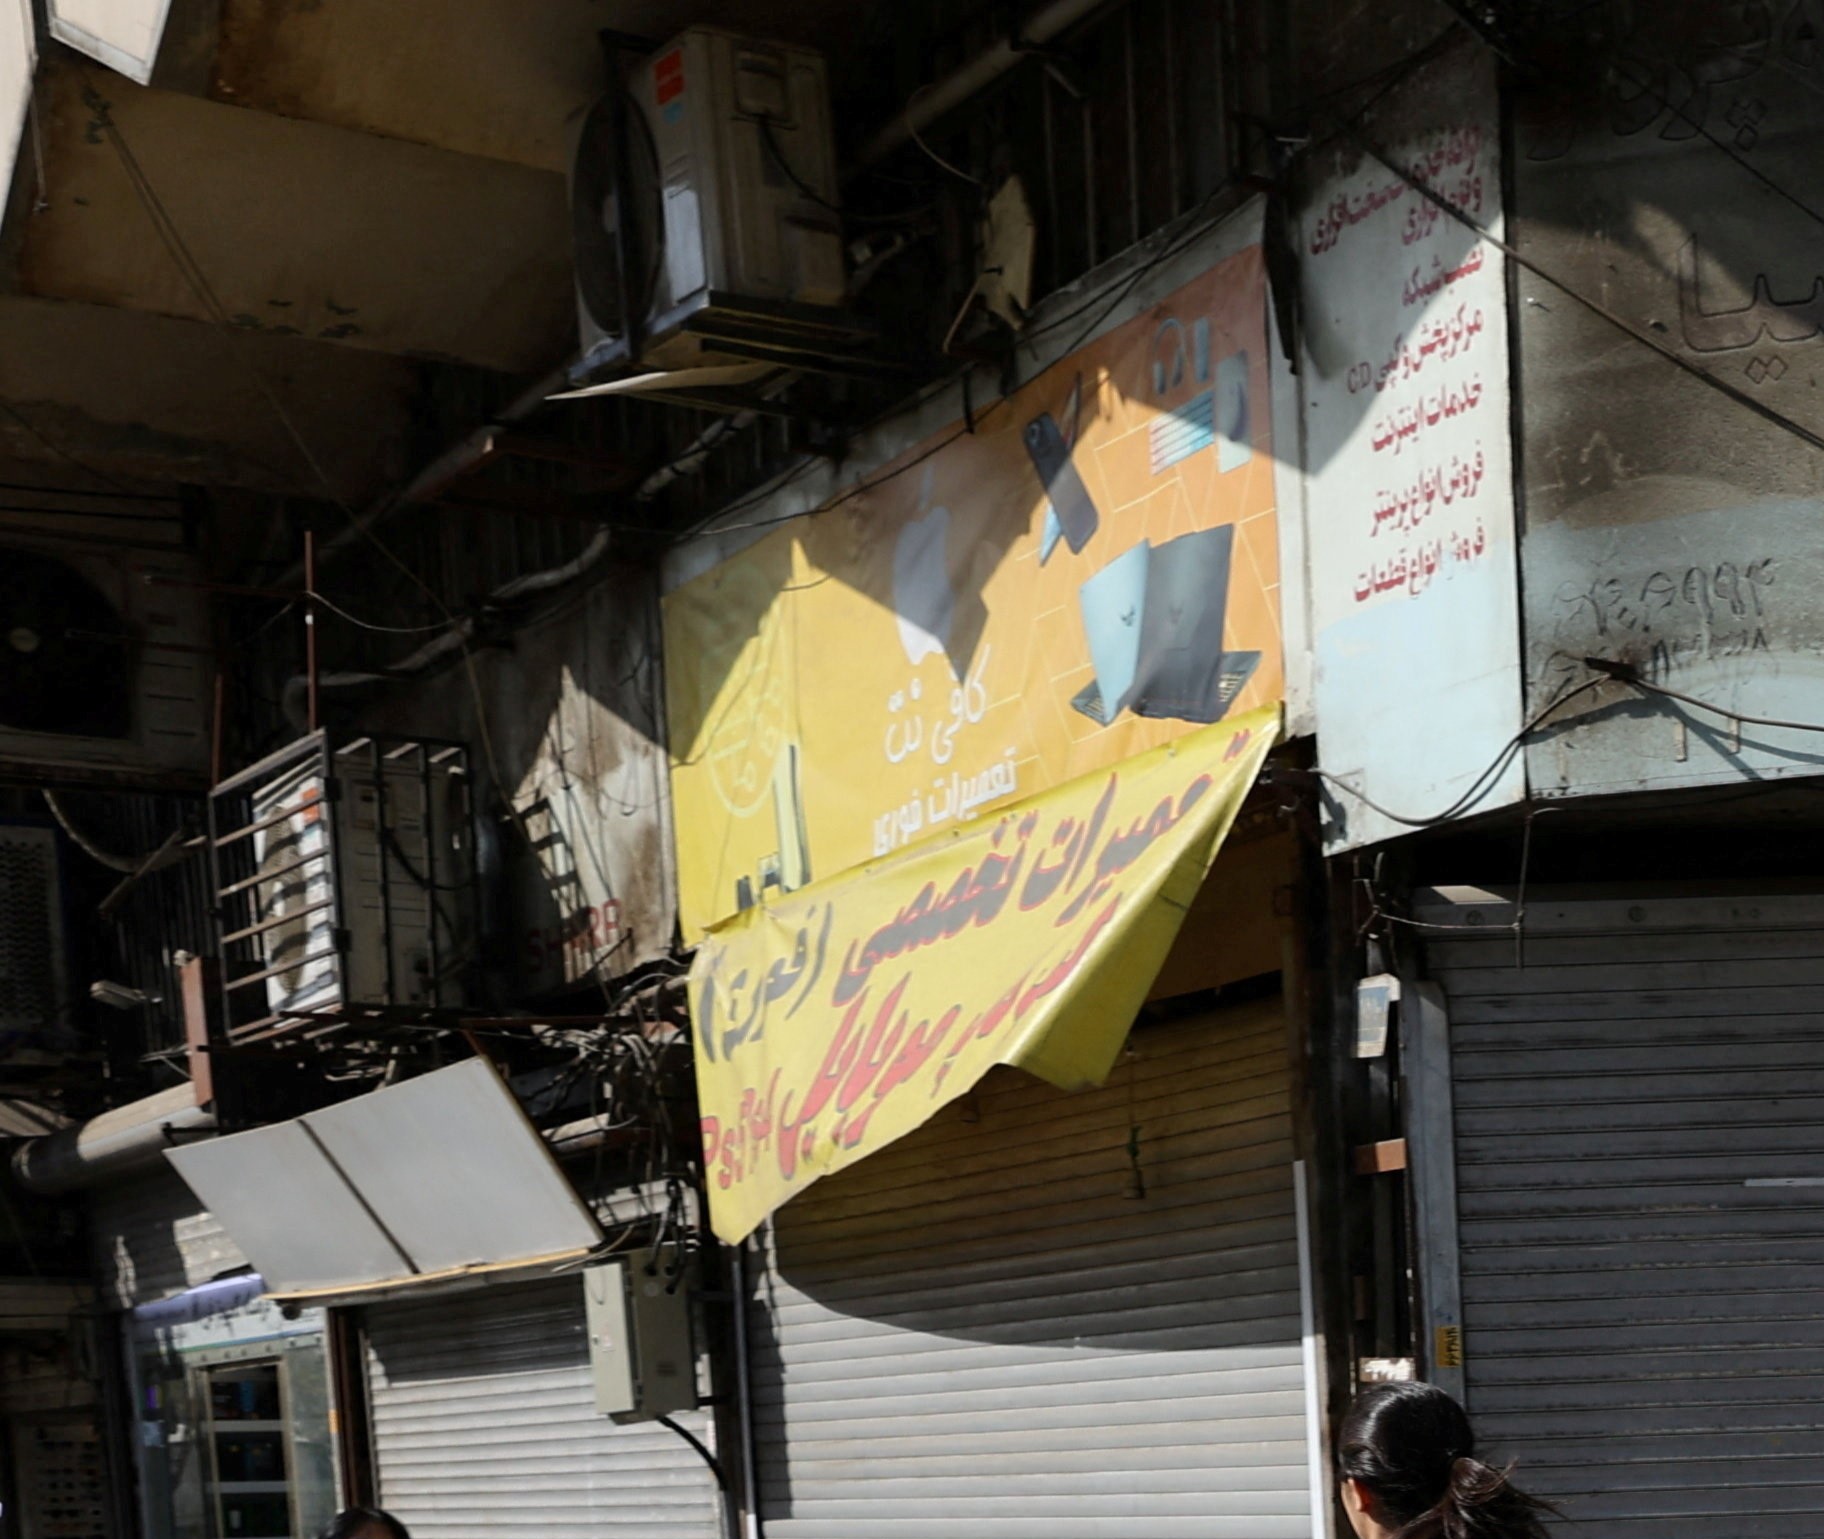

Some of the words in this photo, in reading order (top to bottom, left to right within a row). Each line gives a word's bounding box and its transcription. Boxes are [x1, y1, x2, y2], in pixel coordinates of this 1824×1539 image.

[1347, 361, 1372, 394] CD
[1426, 372, 1482, 427] خدمات
[1371, 394, 1426, 456] اینترنت
[1440, 440, 1484, 505] فروش
[1354, 547, 1407, 602] قطعات
[885, 677, 923, 764] نت
[931, 643, 992, 765] کافی
[928, 746, 1017, 823] تعمیرات
[873, 788, 922, 858] فوری
[832, 810, 1042, 1007] تخصصی
